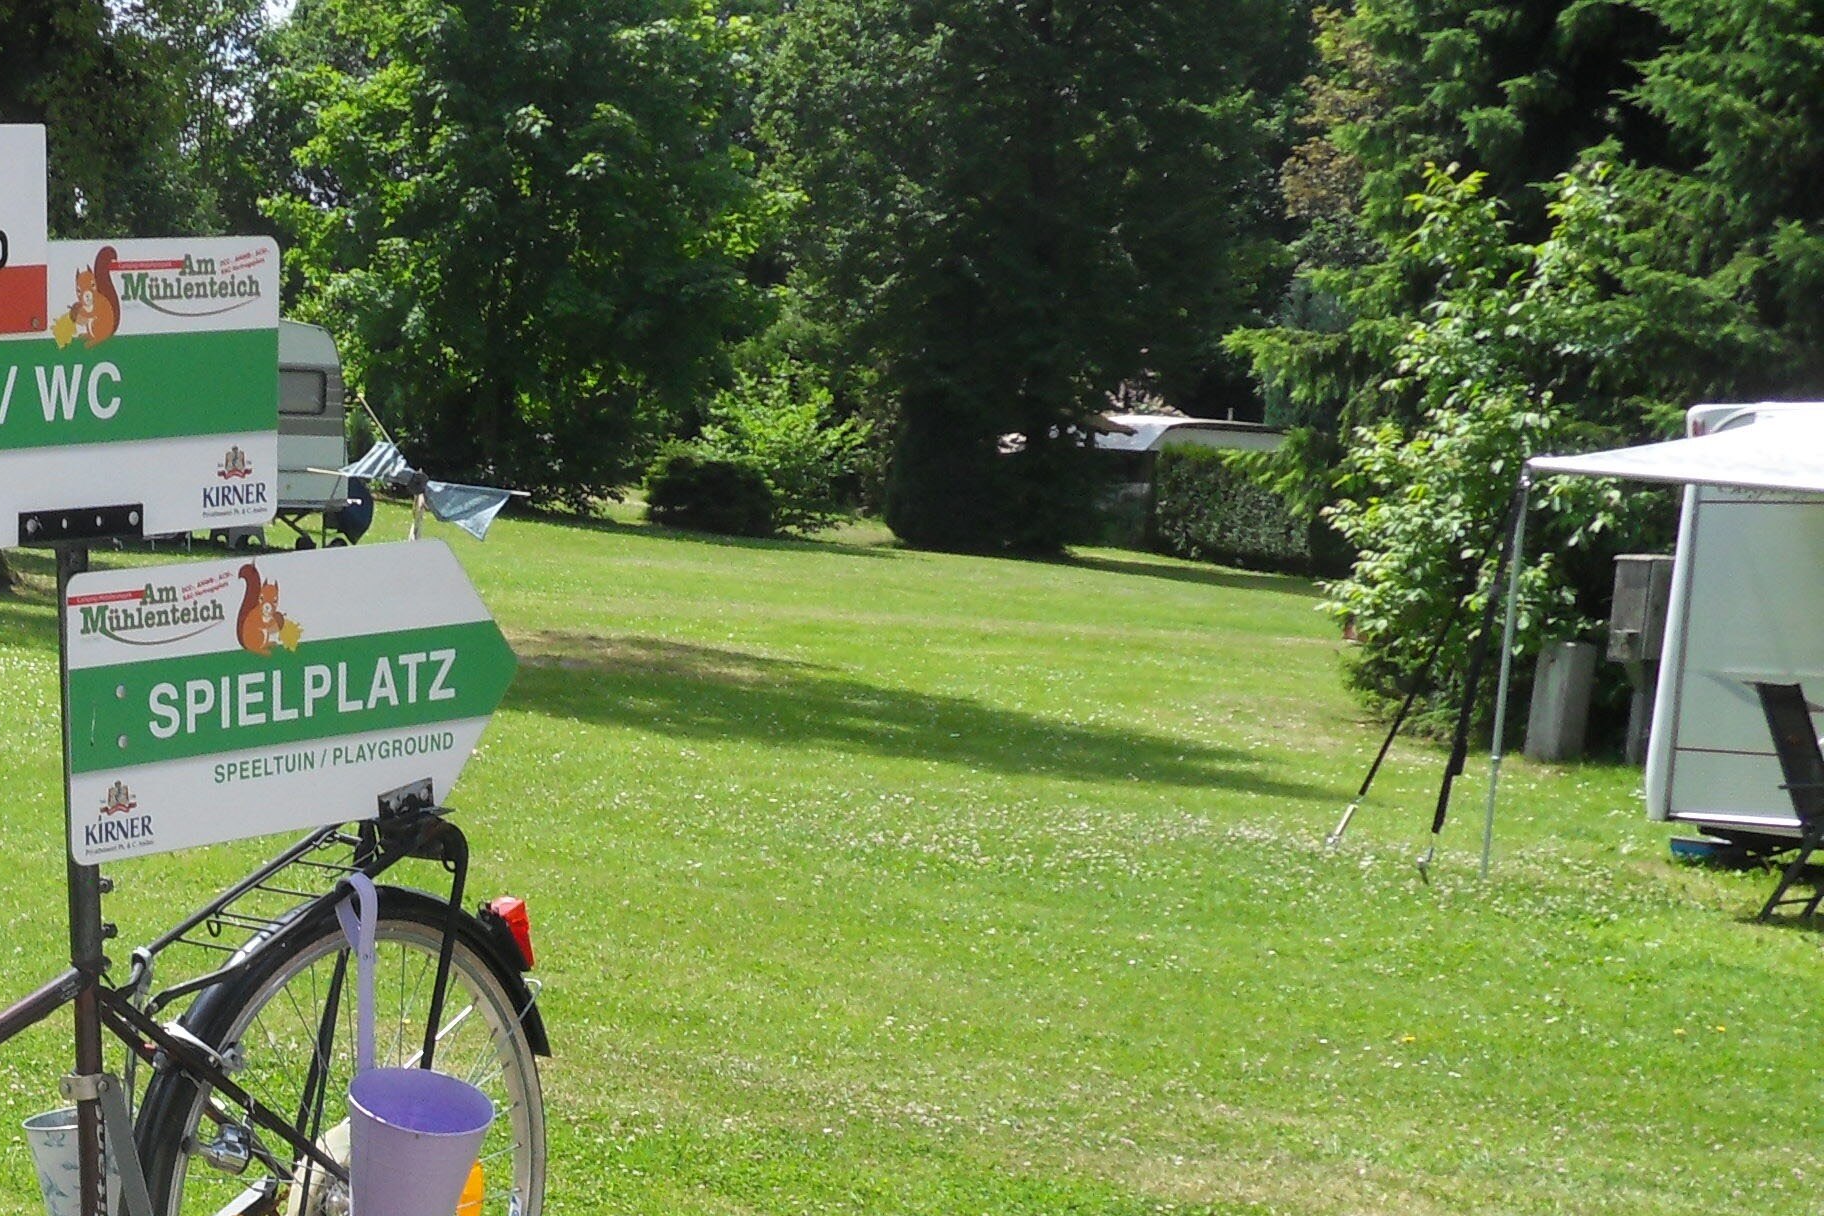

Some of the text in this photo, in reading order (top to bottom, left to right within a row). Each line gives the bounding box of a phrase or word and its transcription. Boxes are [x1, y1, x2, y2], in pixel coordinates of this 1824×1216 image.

[179, 254, 216, 276] Am
[121, 272, 261, 300] Mühlenteich
[36, 361, 122, 421] WC
[203, 482, 267, 508] KIRNER
[139, 583, 178, 606] Am
[80, 600, 225, 634] Mühlenteich
[148, 649, 457, 739] SPIELPLATZ
[214, 751, 315, 783] SPEELTUIN
[333, 732, 454, 765] PLAYGROUND
[85, 815, 154, 846] KIRNER
